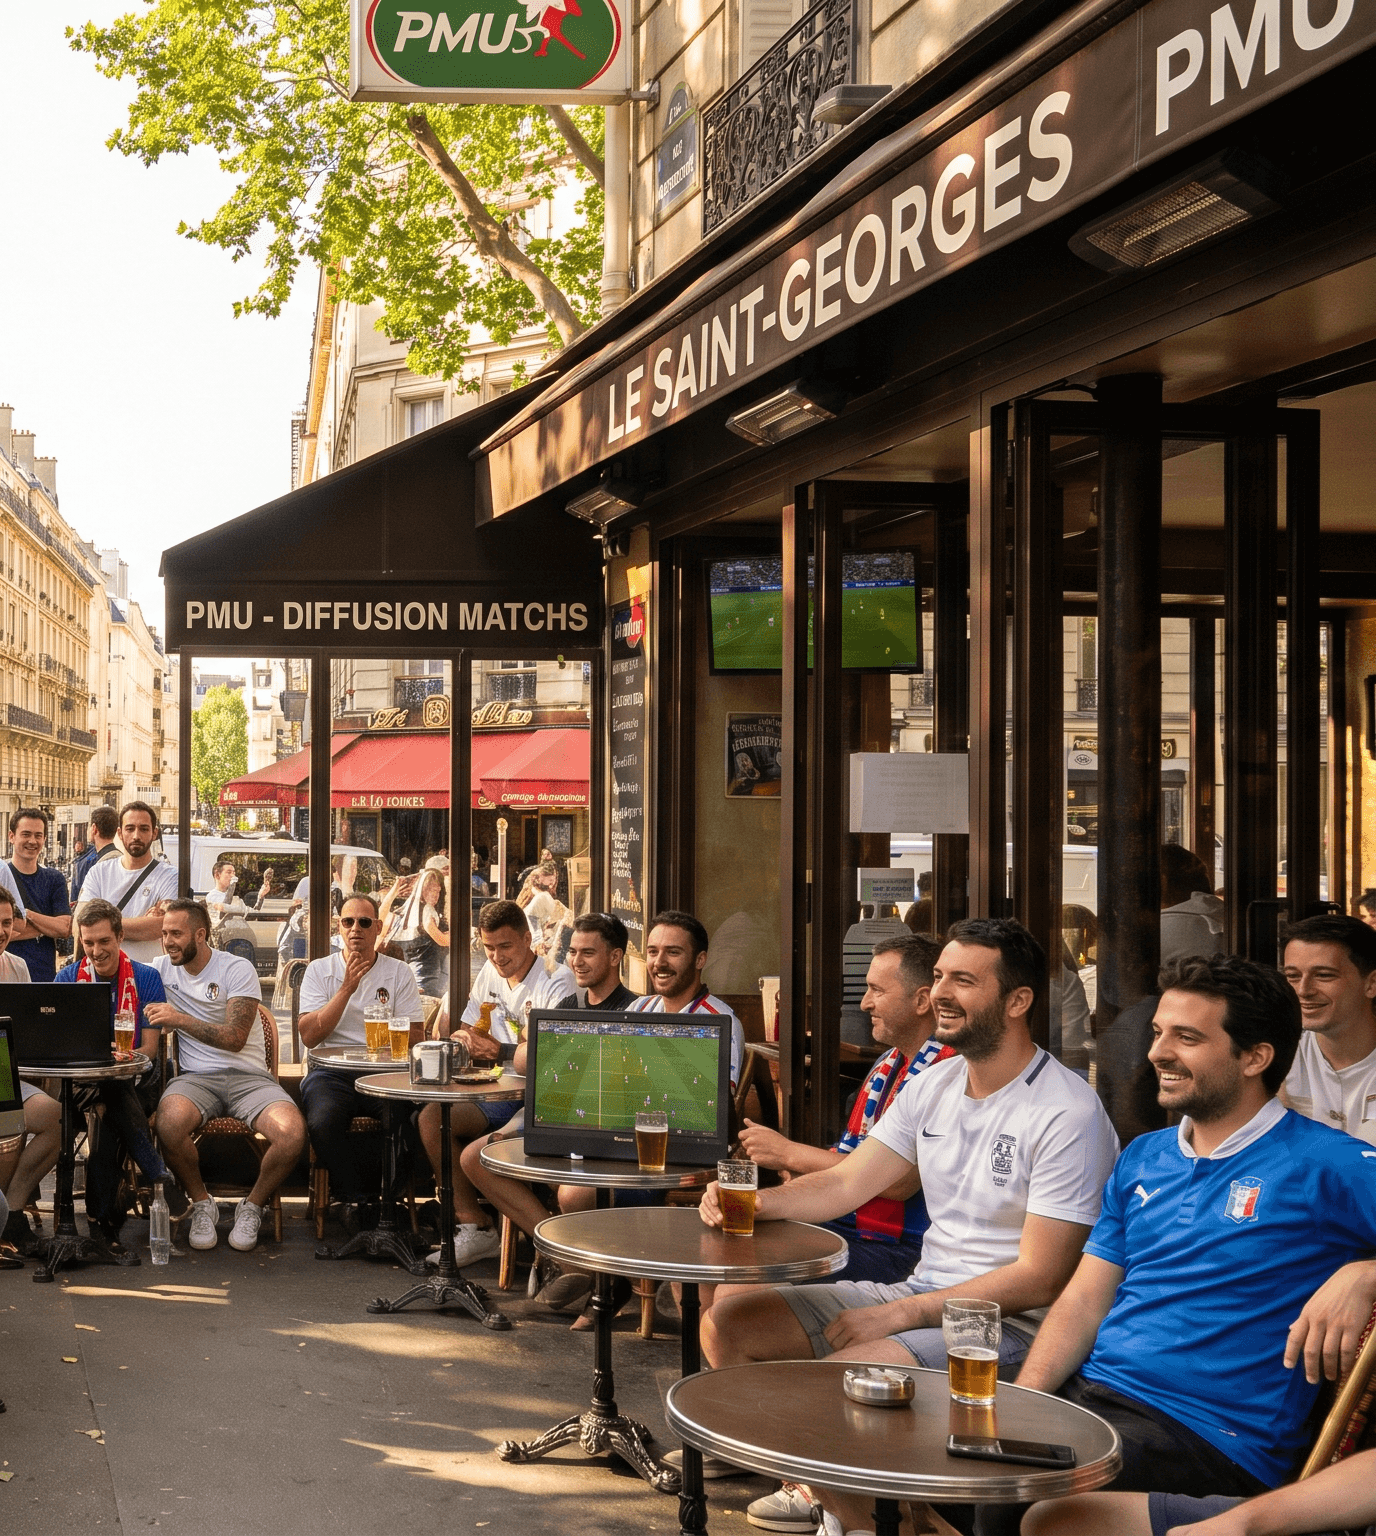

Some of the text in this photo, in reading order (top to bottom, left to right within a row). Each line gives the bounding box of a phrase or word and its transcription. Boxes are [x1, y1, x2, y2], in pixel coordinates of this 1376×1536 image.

[393, 11, 519, 54] PMU
[1155, 0, 1355, 136] PMU
[607, 91, 1073, 444] LE SAINT-GEORGES
[186, 601, 253, 630] PMU
[283, 601, 448, 631] DIFFUSION
[459, 602, 588, 631] MATCHS
